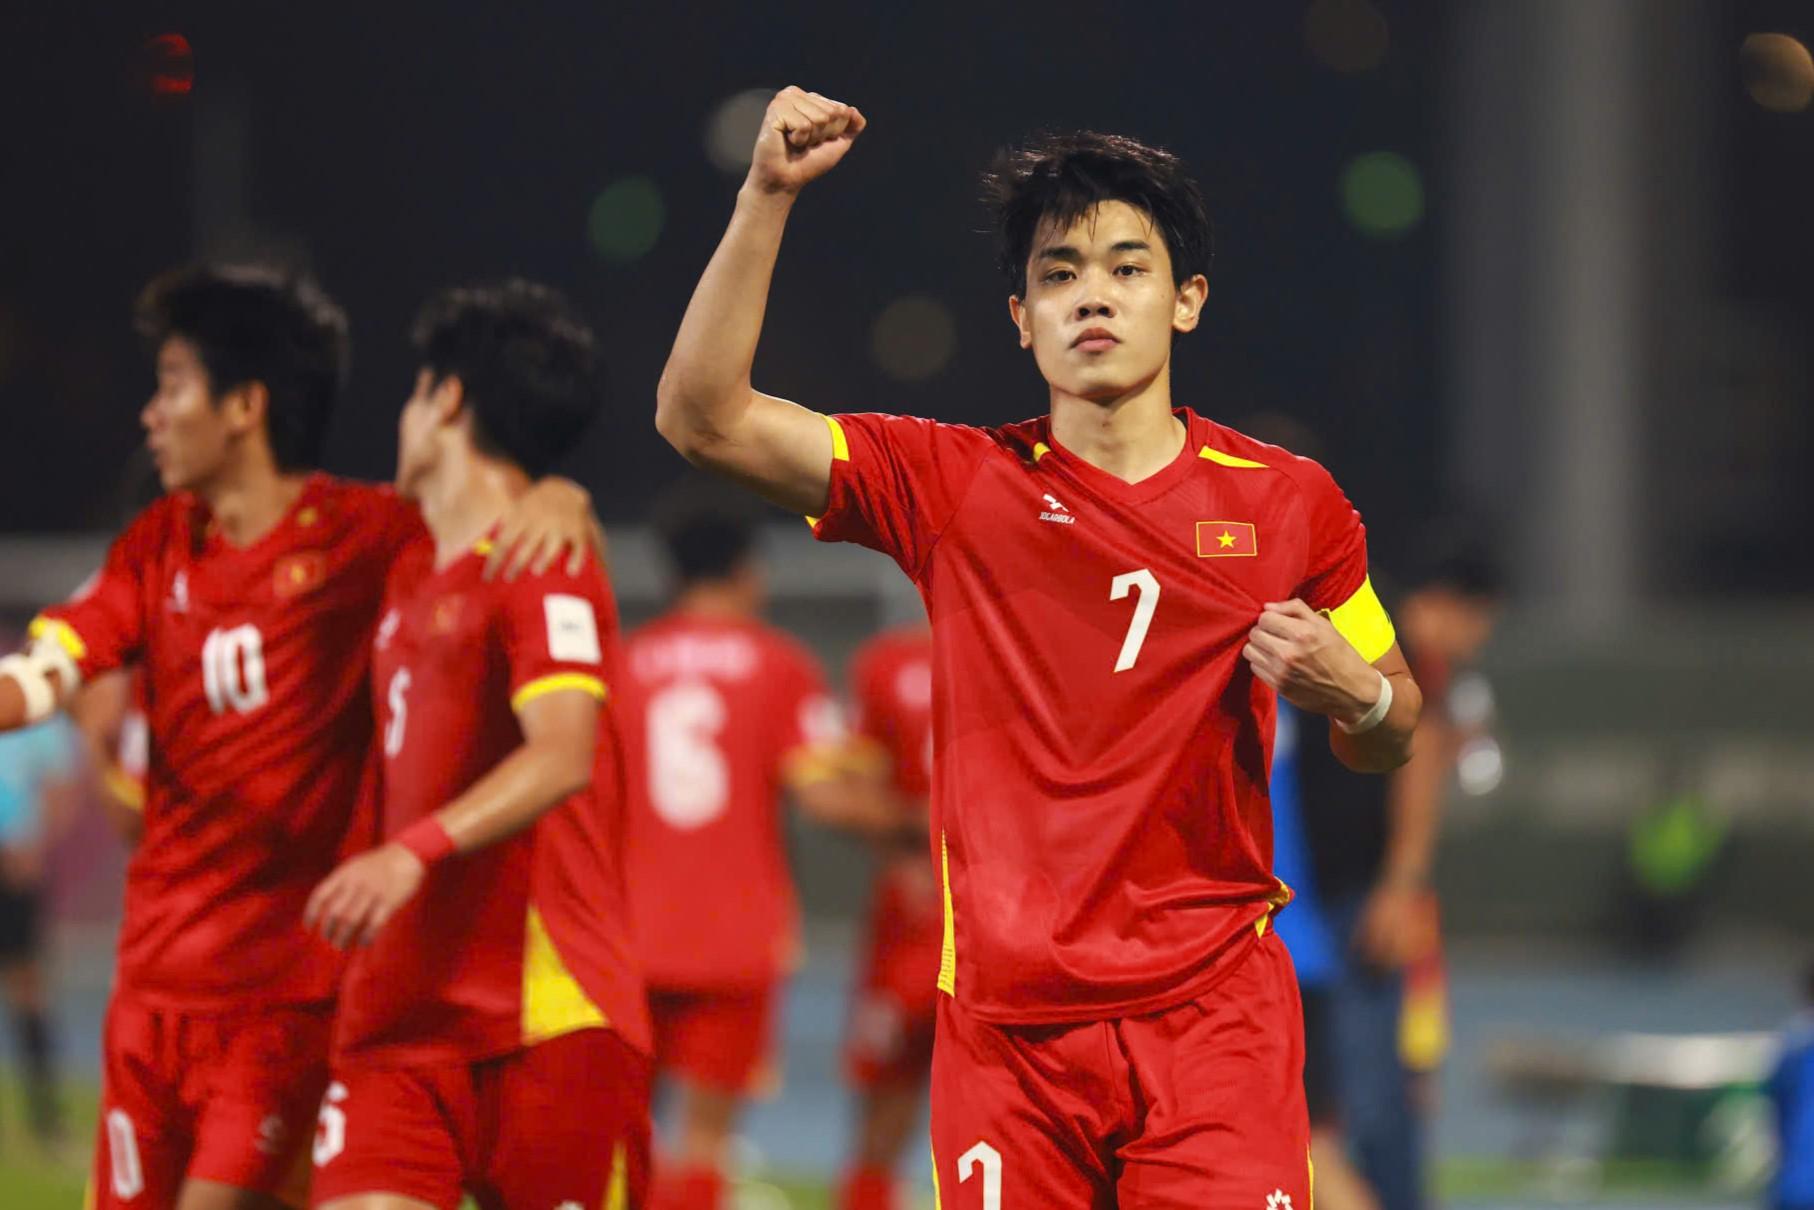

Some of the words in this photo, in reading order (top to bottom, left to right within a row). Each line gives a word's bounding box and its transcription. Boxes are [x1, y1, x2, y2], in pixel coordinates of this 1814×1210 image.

[203, 624, 268, 713] 10
[1110, 568, 1161, 673] 7
[648, 682, 728, 828] 6
